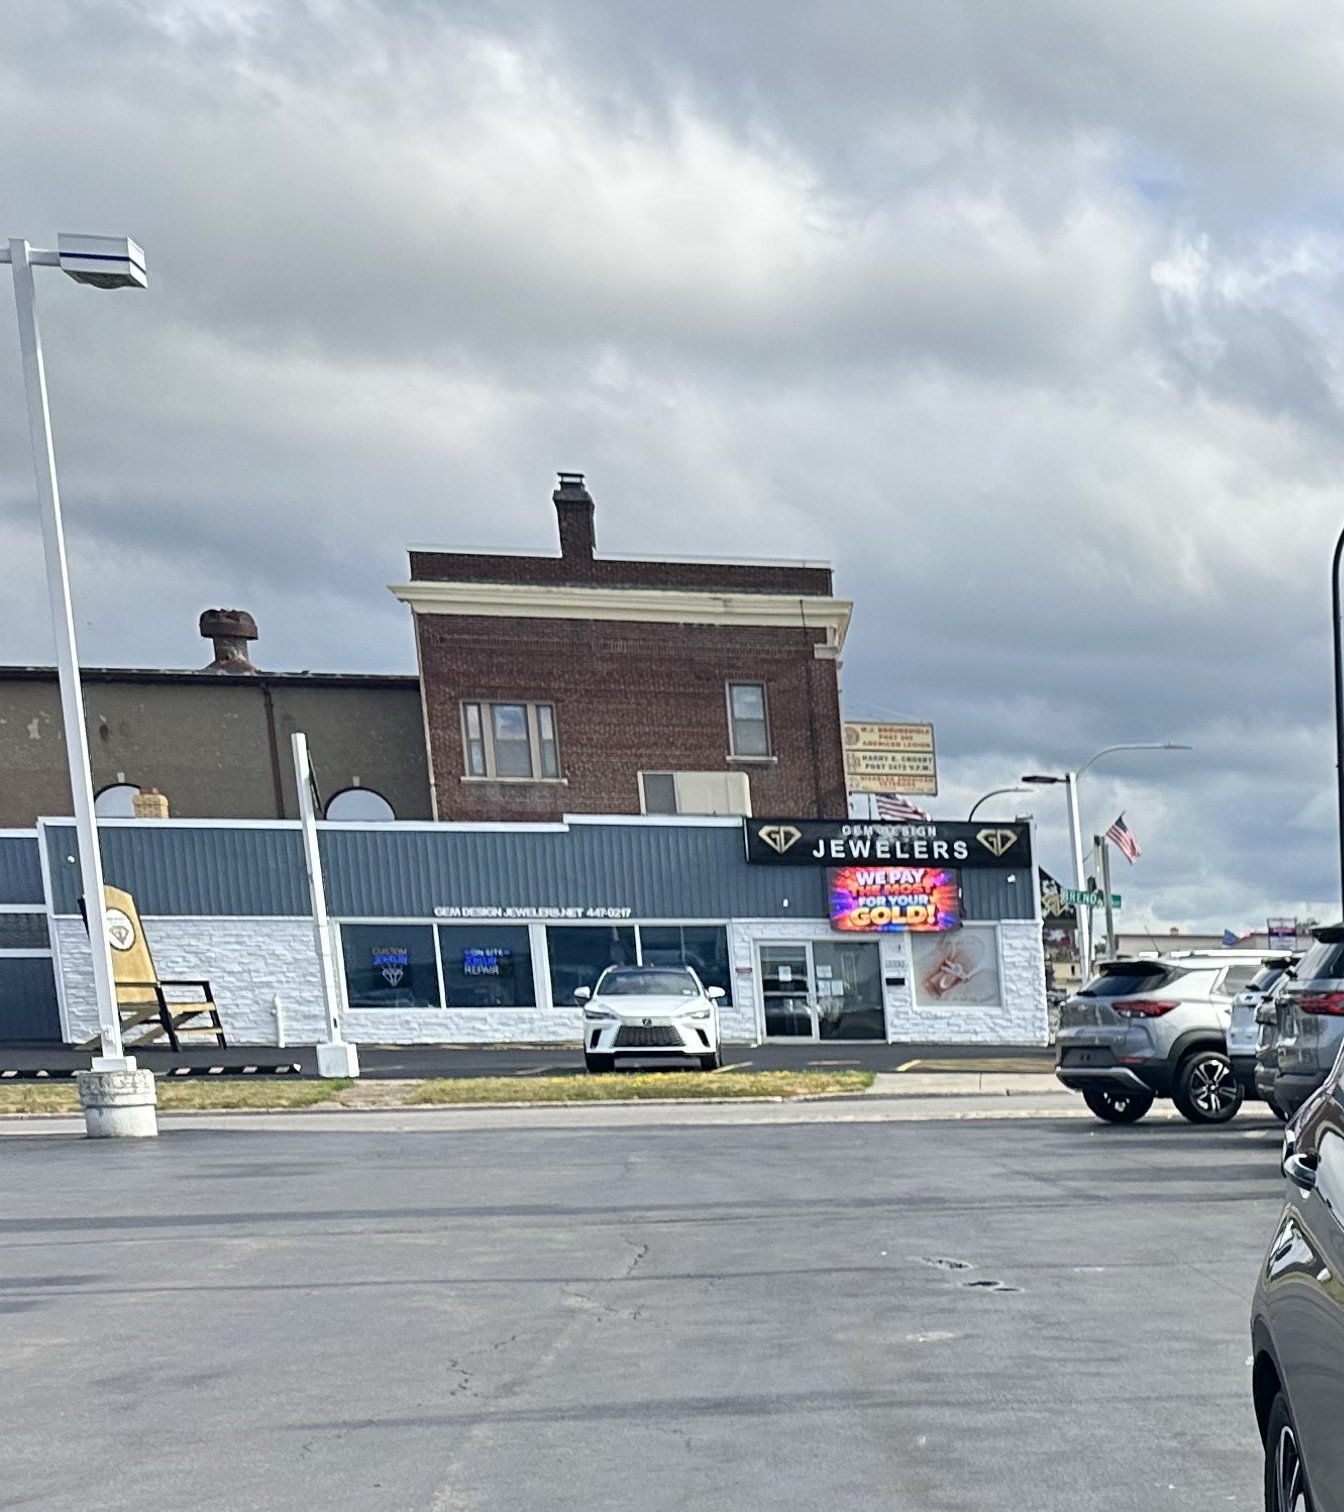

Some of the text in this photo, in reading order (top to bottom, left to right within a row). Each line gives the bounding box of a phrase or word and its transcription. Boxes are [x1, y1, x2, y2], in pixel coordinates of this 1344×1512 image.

[812, 839, 969, 860] JEWELERS
[856, 868, 925, 886] WE PAY
[848, 883, 934, 897] THE MOST
[858, 894, 929, 907] FOR YOUR
[433, 906, 461, 917] GEM
[462, 906, 502, 917] DESIGN
[849, 904, 937, 927] GOLD!
